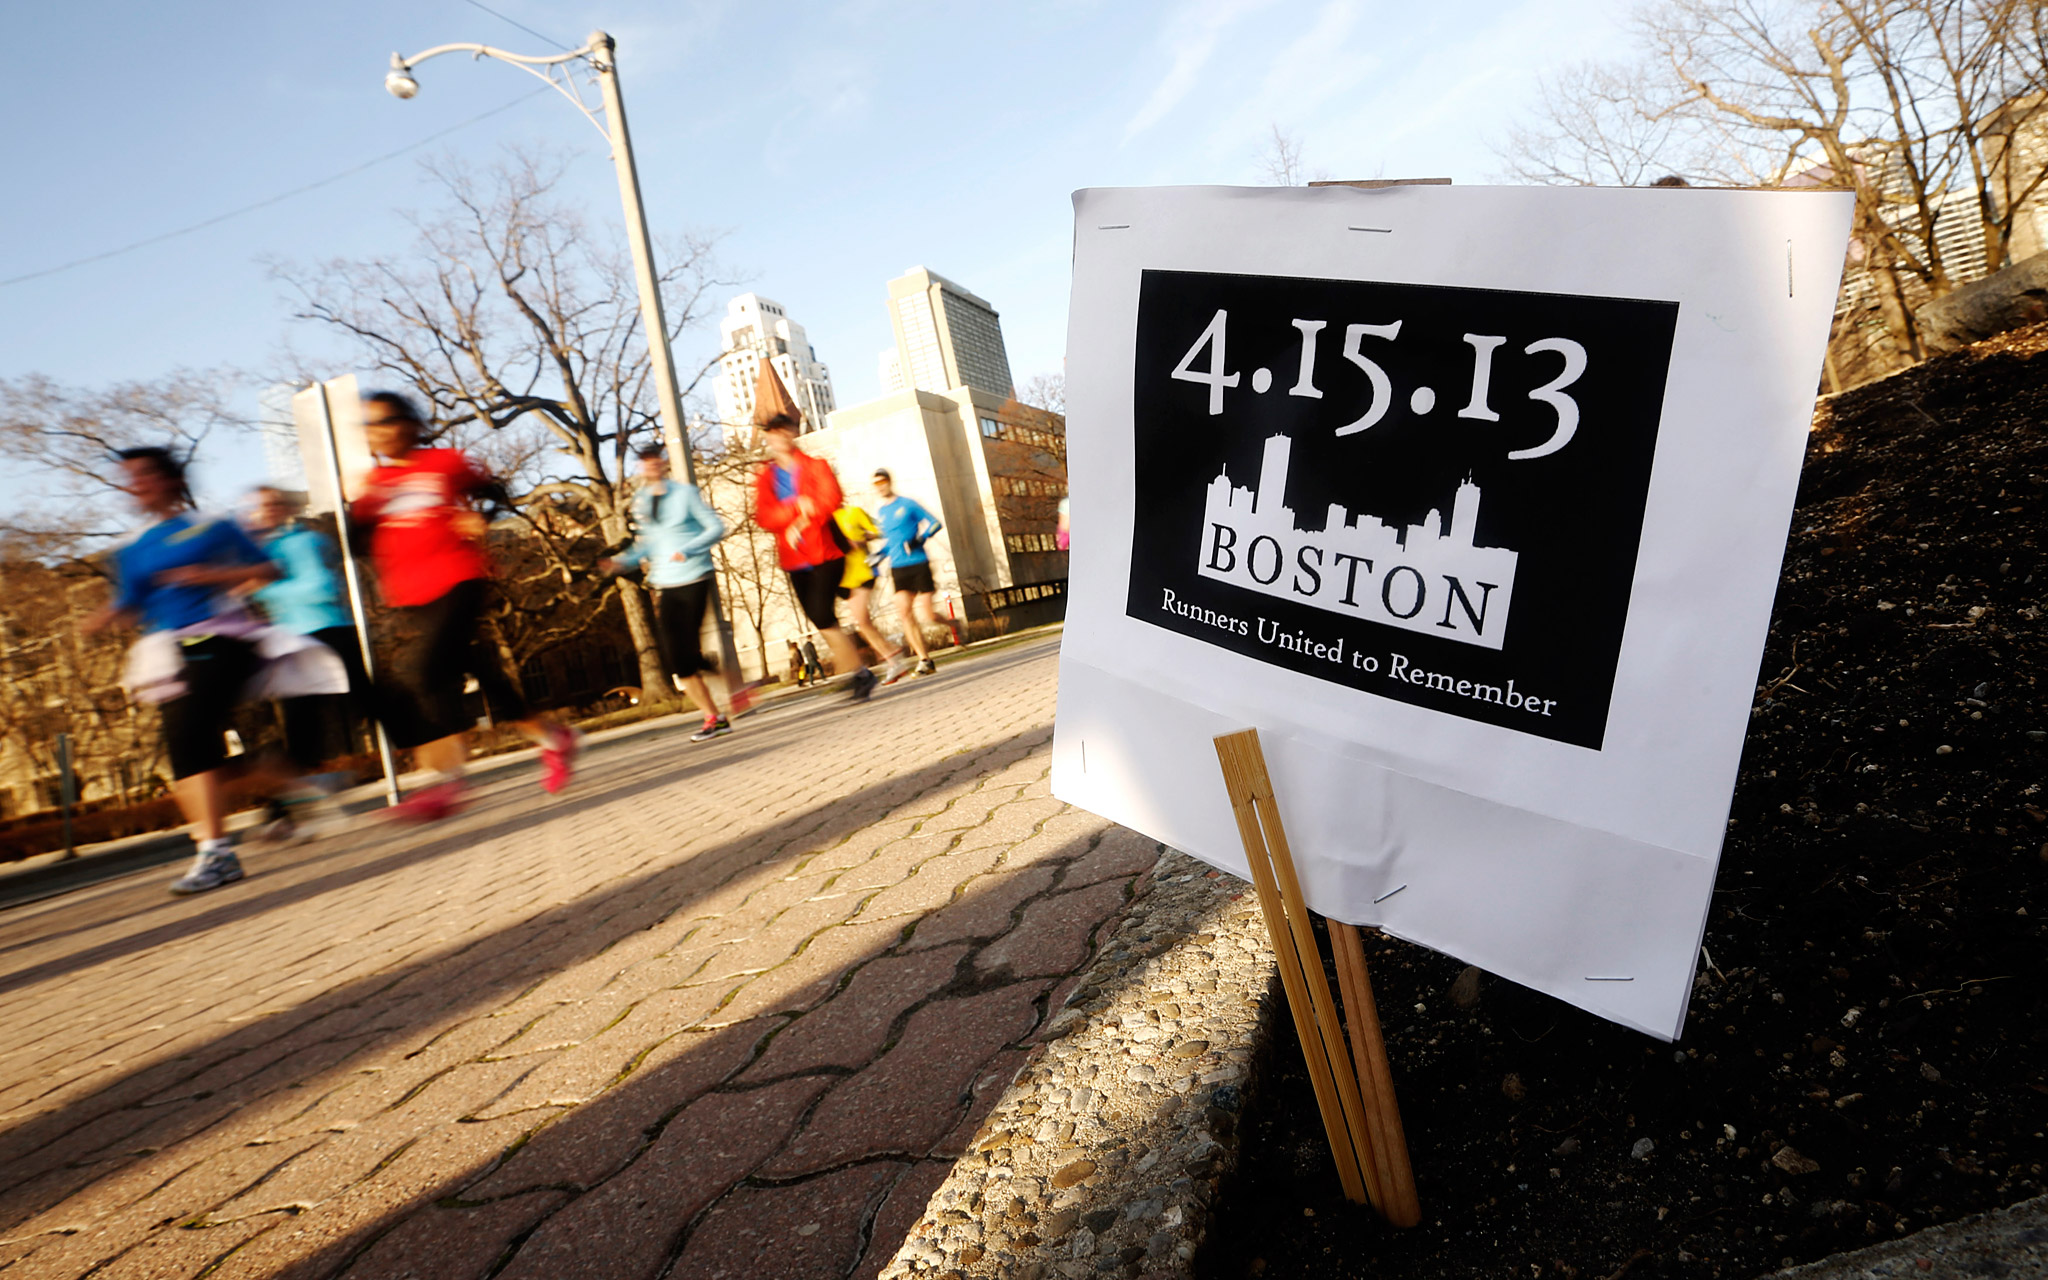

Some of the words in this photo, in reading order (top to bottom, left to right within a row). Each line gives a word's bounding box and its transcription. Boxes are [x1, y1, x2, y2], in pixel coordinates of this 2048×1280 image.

[1171, 309, 1588, 460] 4.15.13
[1206, 523, 1499, 636] BOSTON
[1161, 588, 1249, 636] Runners
[1257, 618, 1343, 664] United
[1353, 651, 1379, 673] to
[1388, 653, 1557, 717] Remember
